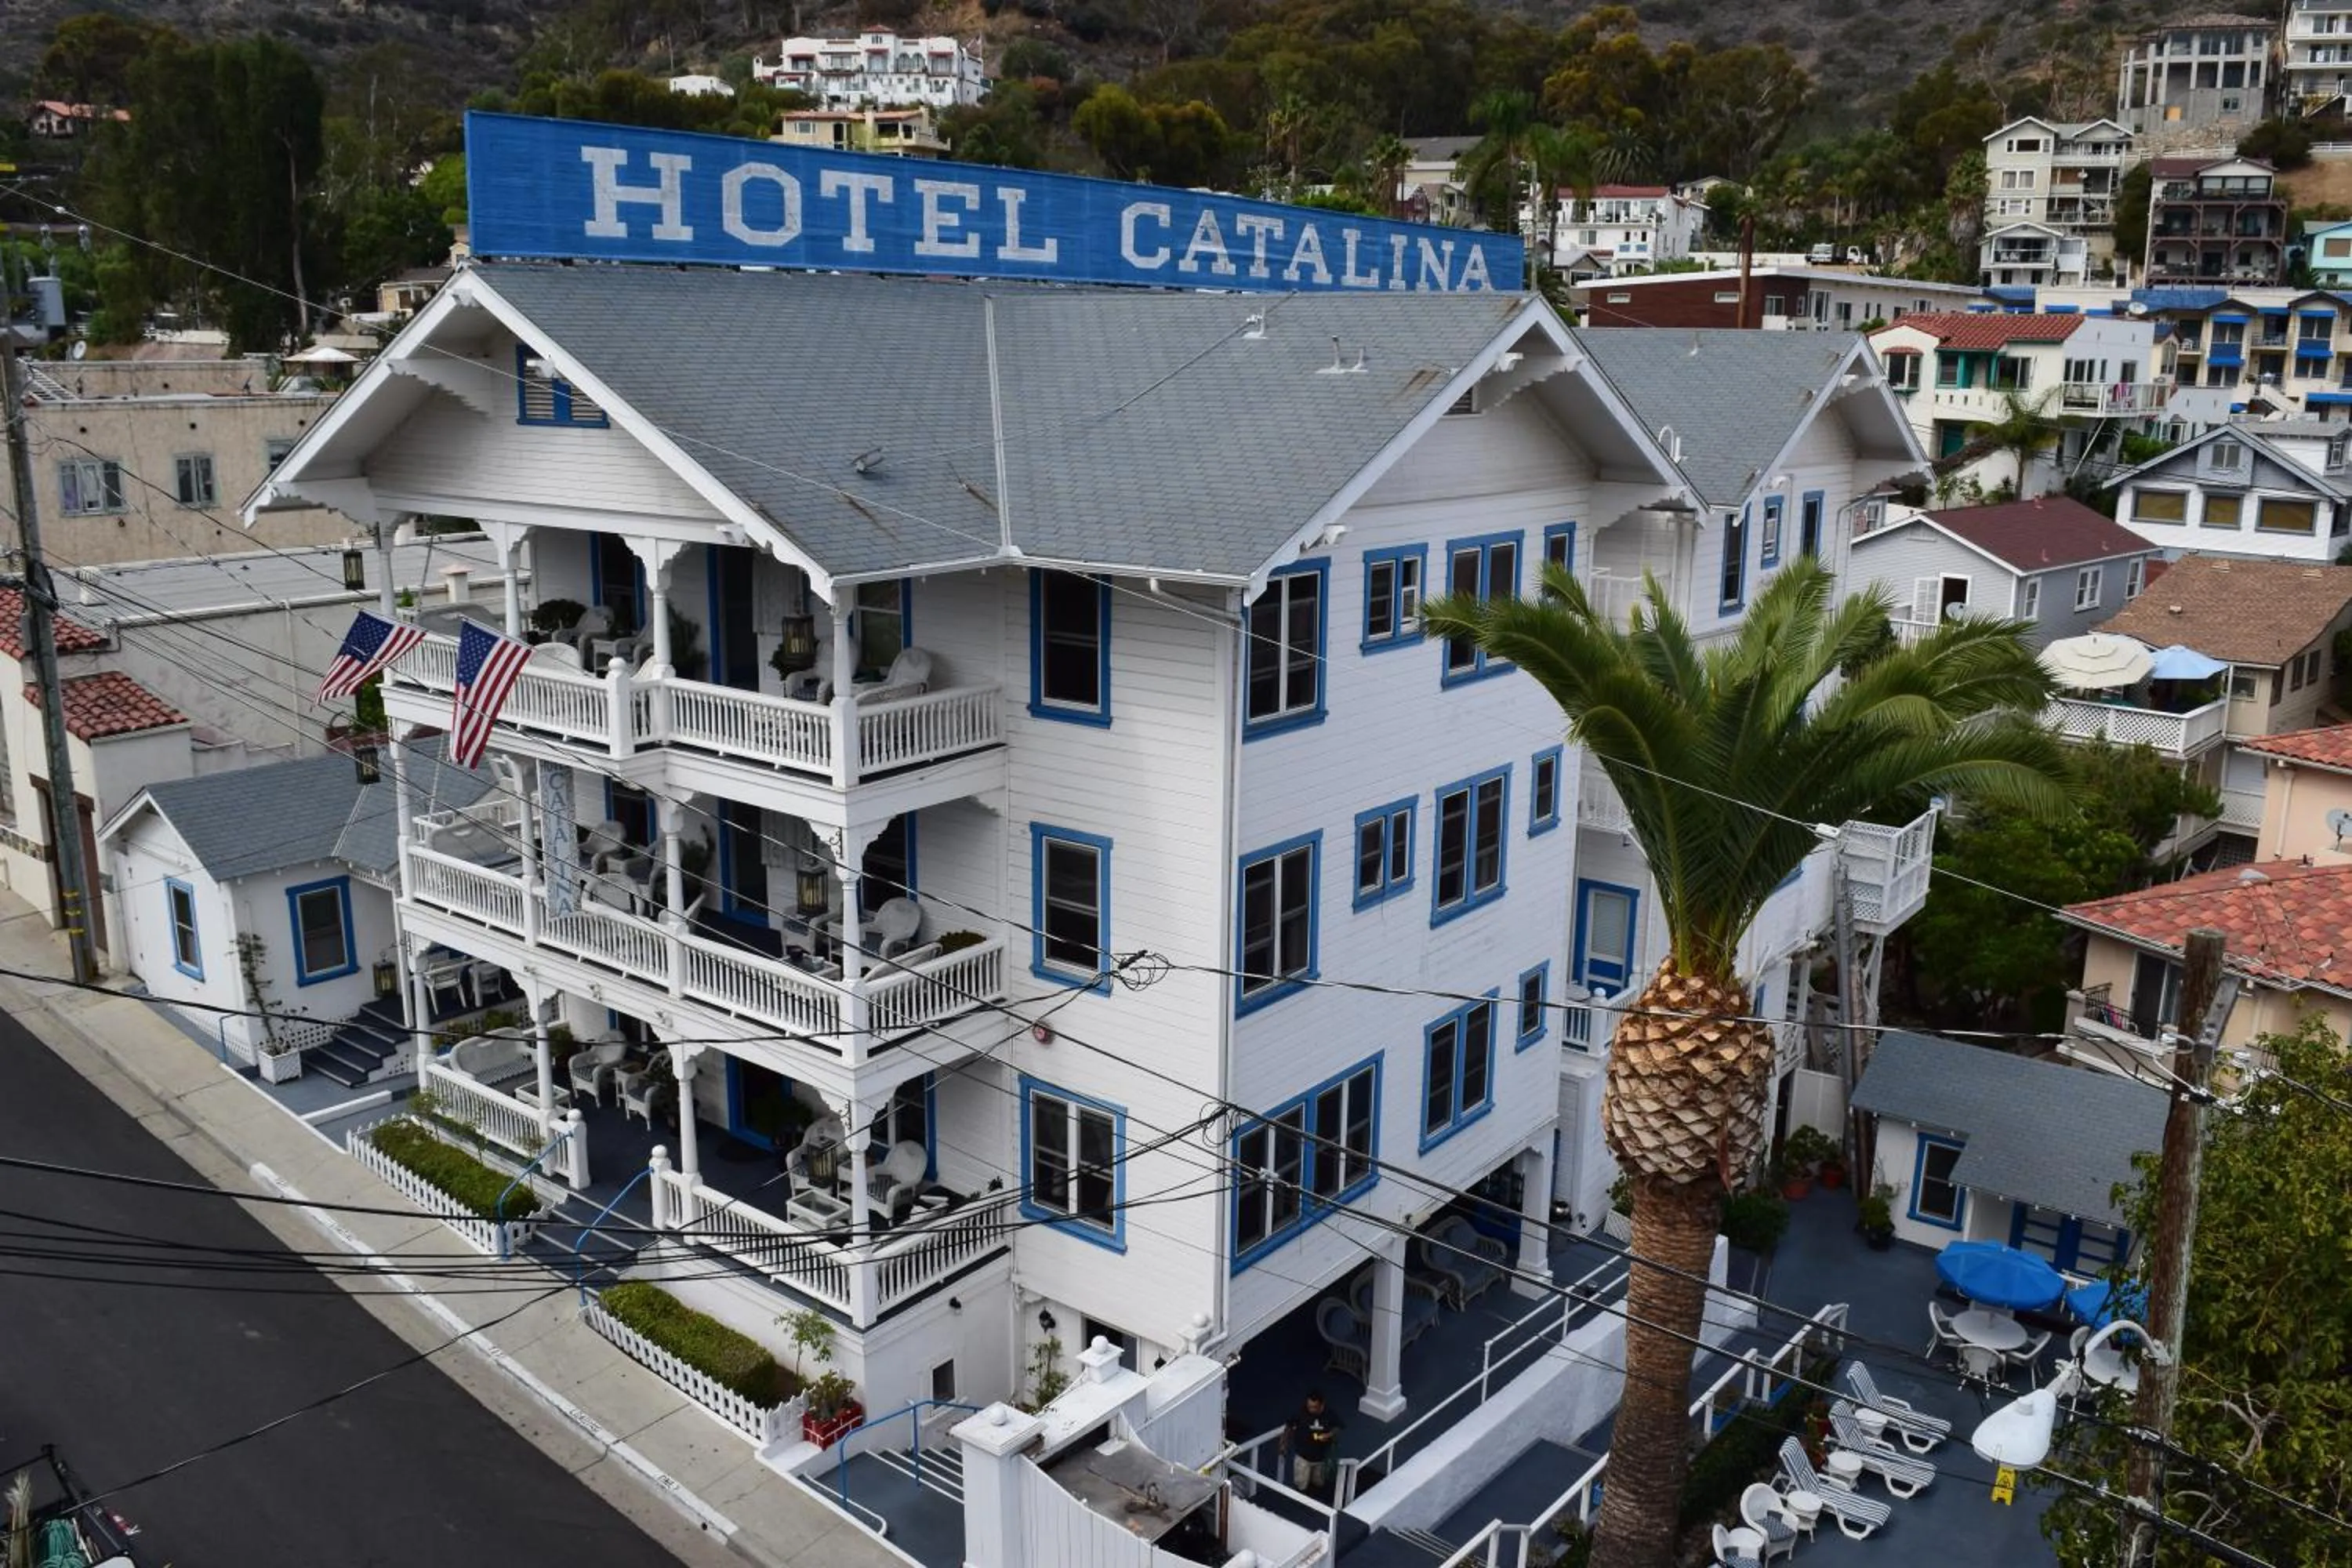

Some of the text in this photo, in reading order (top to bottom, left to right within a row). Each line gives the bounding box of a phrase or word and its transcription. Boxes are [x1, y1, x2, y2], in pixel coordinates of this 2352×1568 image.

[581, 146, 1494, 291] HOTEL CATALINA
[550, 772, 573, 917] CATALINA
